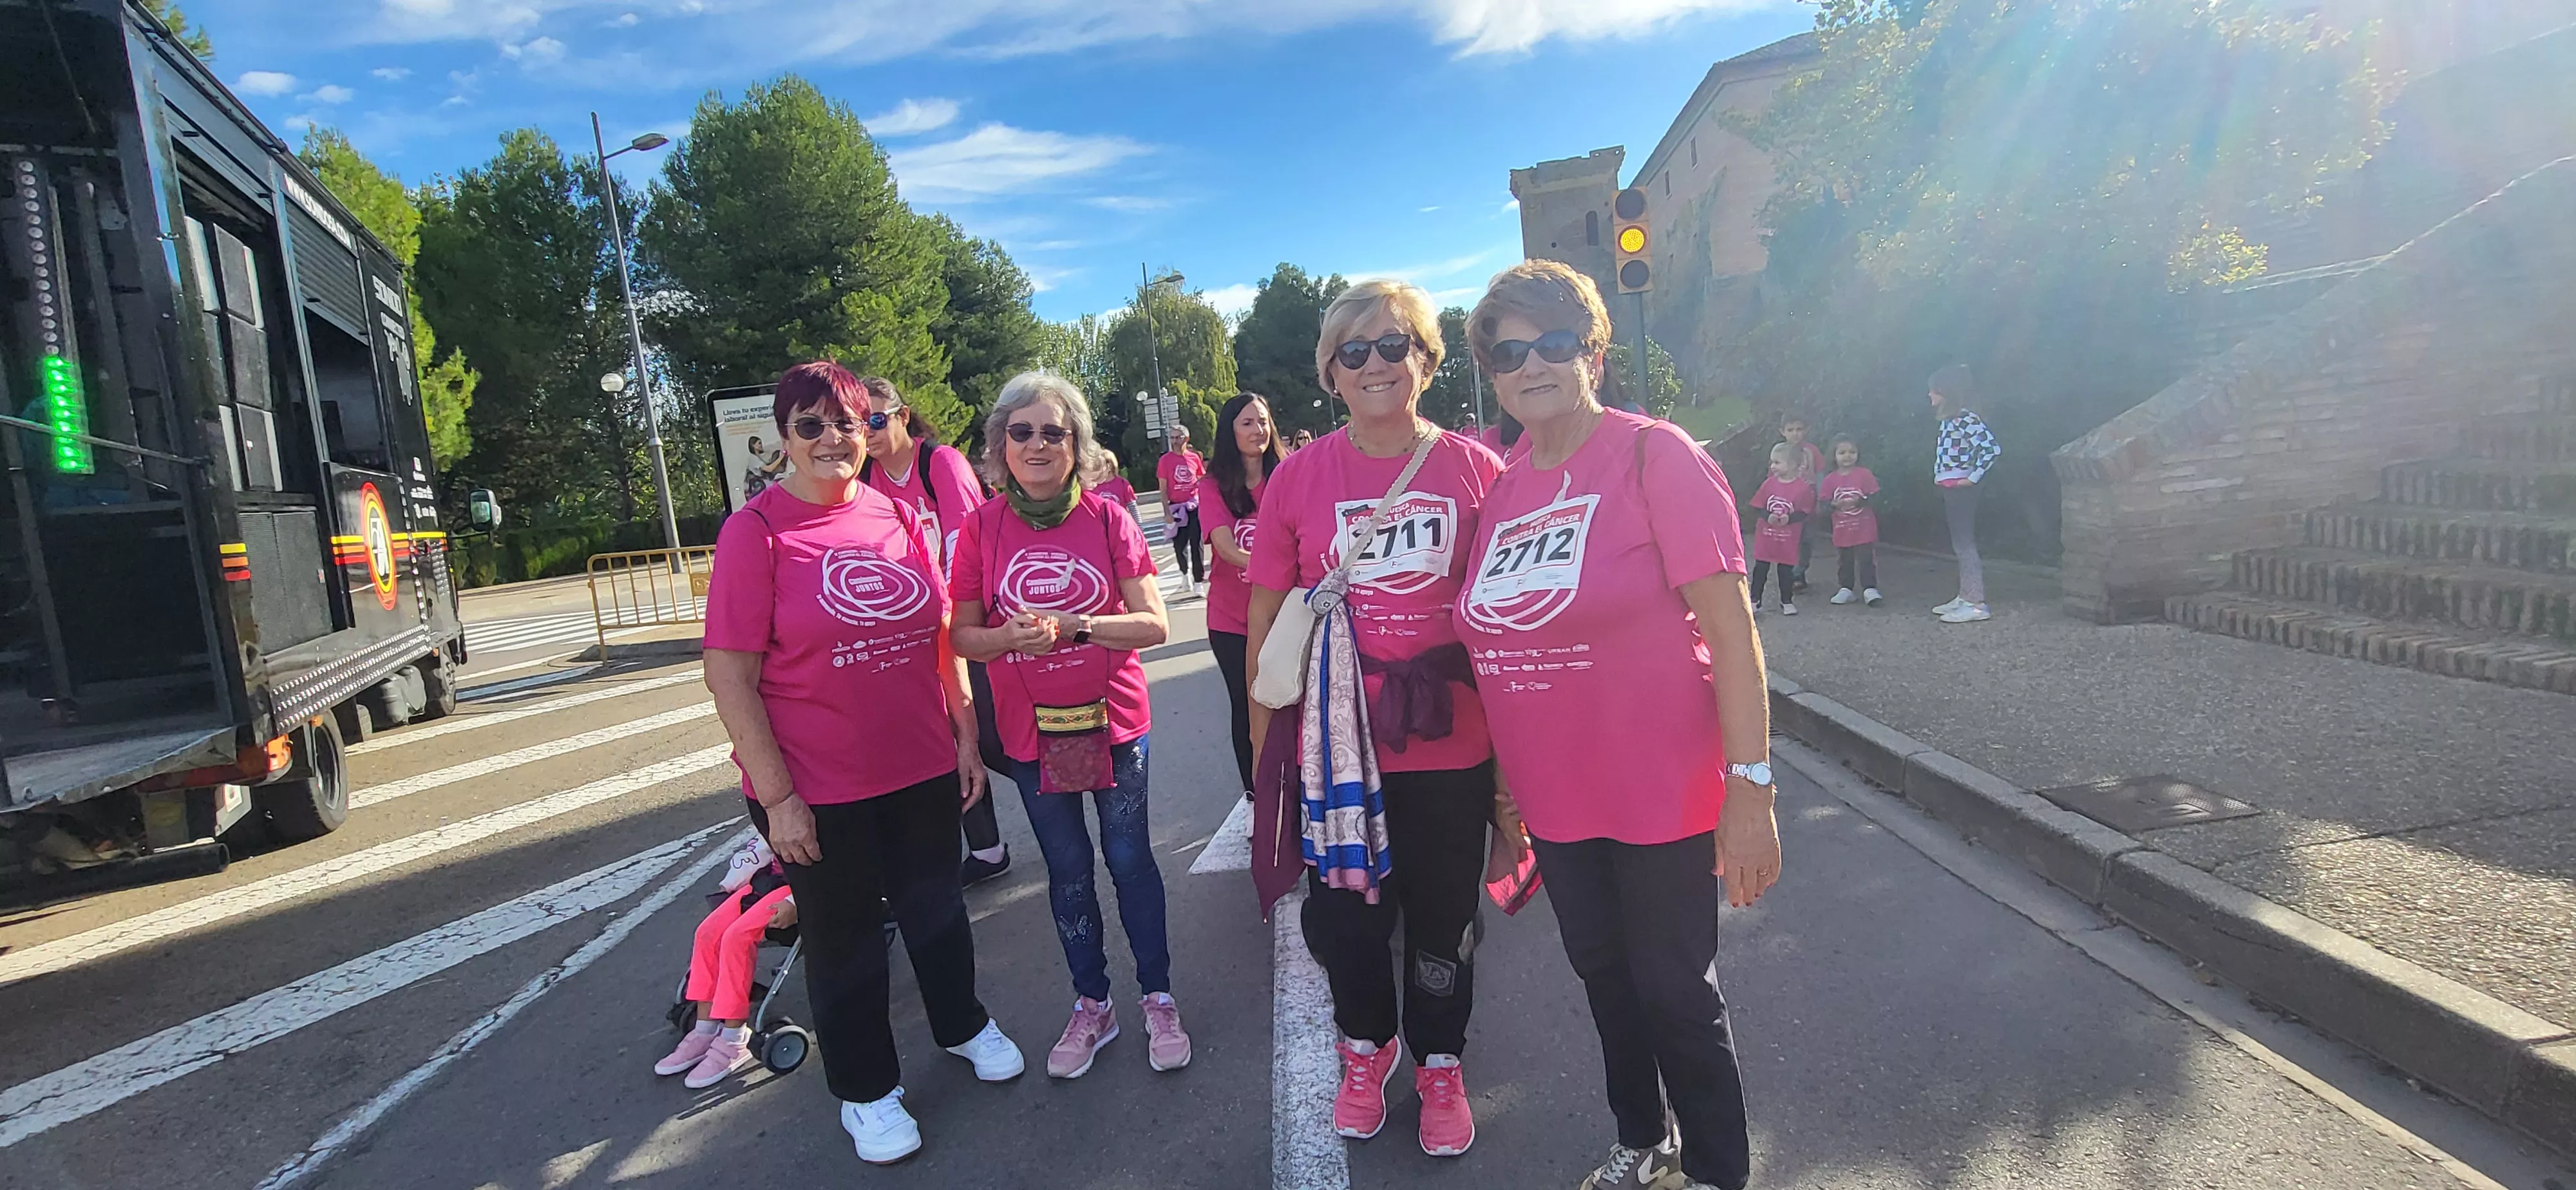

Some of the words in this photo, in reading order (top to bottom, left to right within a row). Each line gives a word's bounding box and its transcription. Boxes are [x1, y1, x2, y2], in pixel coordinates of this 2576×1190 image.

[1405, 505, 1443, 516] CÁNCER
[1502, 528, 1533, 545] CONTRA
[1544, 513, 1580, 528] CÁNCER
[1485, 527, 1575, 578] 2712
[855, 581, 884, 592] JUNTOS
